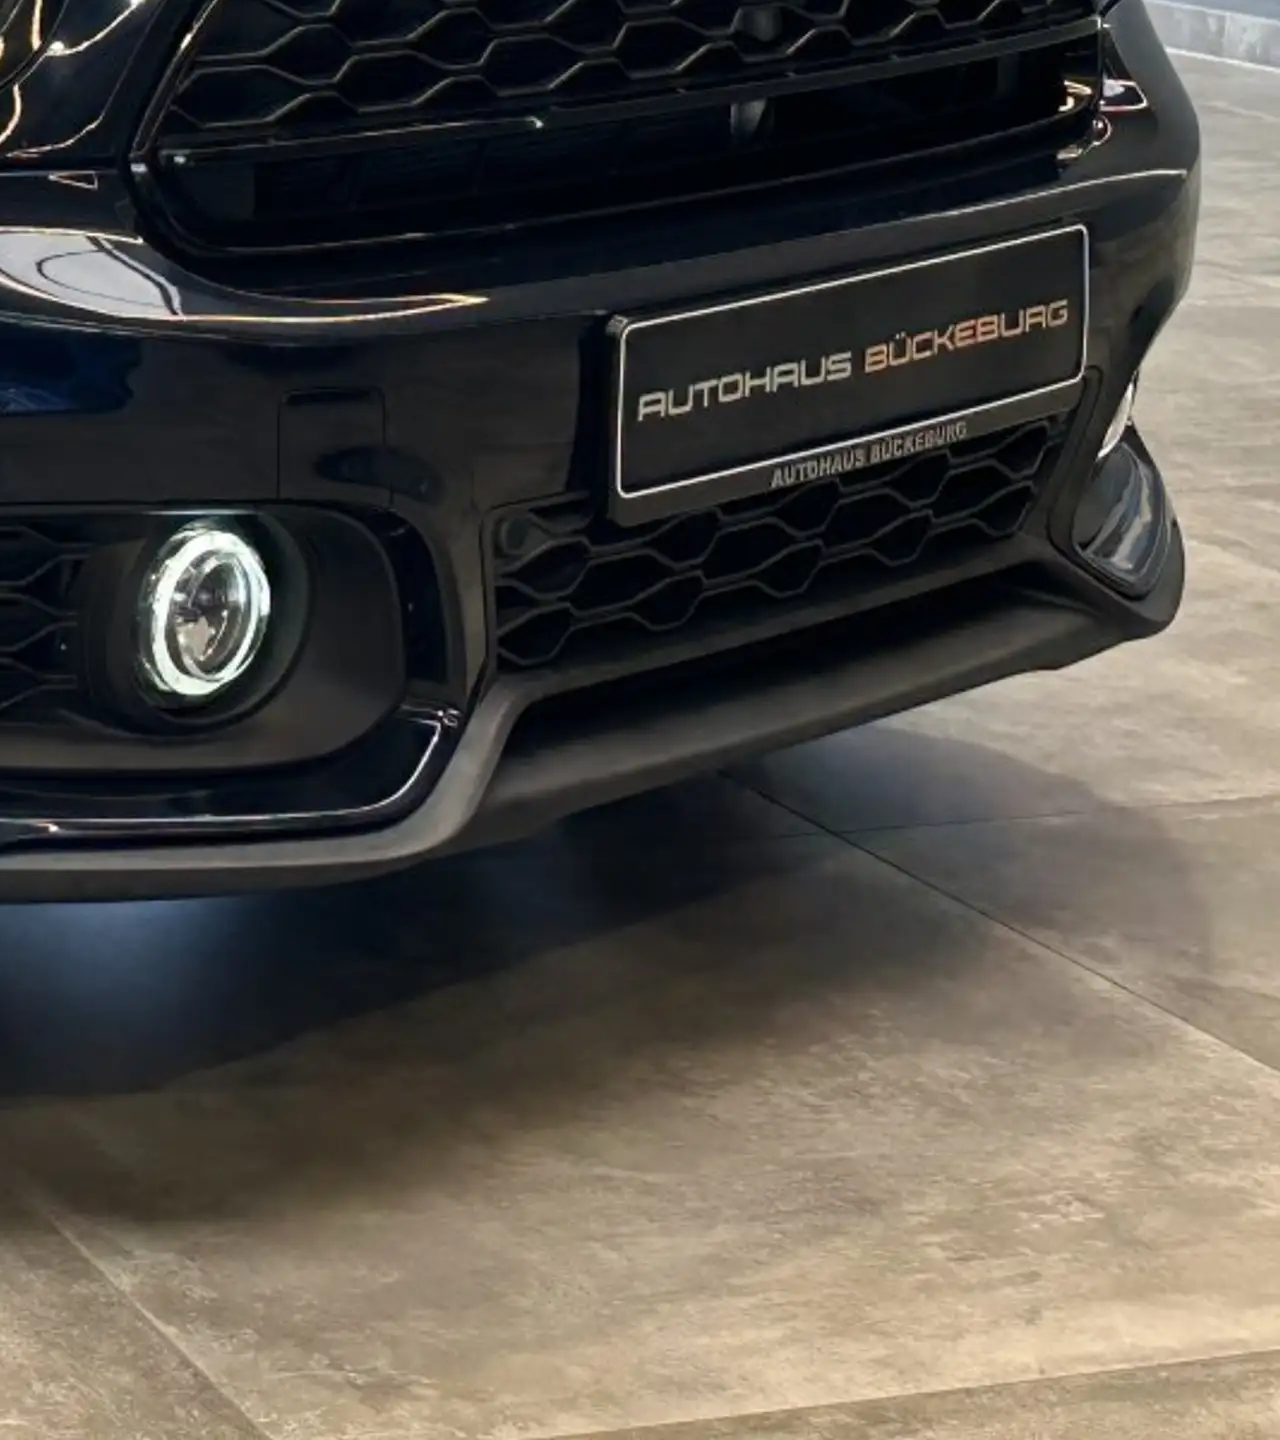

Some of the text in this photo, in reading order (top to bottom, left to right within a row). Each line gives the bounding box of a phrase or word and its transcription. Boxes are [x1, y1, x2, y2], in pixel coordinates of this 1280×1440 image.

[637, 300, 1069, 422] AUTOHAUS BÜCKEBURG
[770, 420, 969, 489] AUTOHAUS BÜCKEBURG
